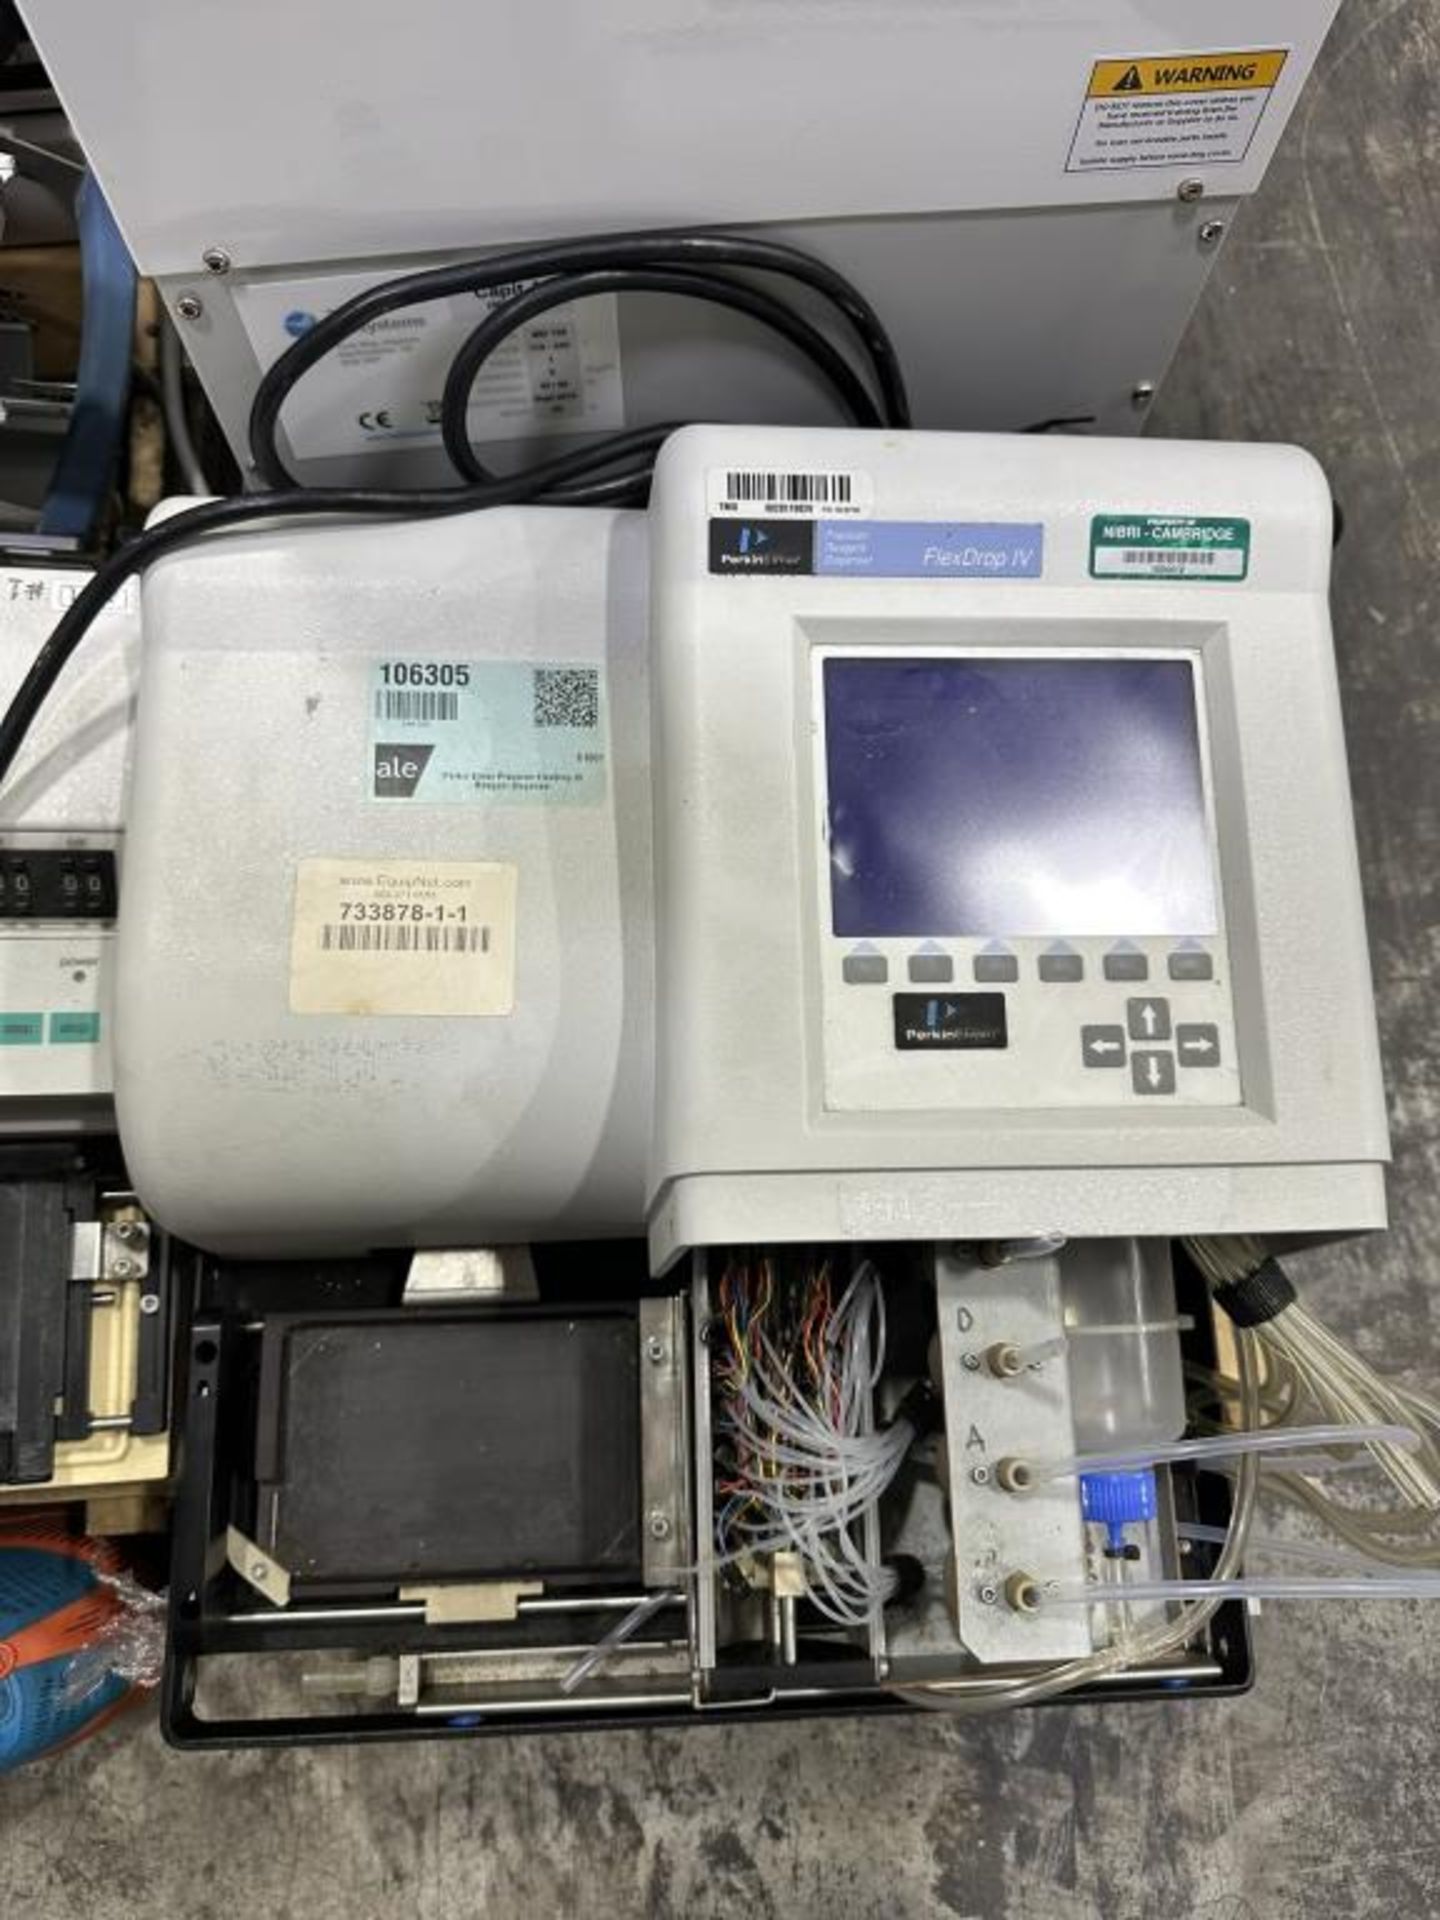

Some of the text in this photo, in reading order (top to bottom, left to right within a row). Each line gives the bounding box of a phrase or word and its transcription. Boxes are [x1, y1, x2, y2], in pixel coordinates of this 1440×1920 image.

[1153, 63, 1257, 85] WARNING
[1103, 526, 1140, 538] NIBRI
[1151, 527, 1235, 540] CAMBRIDGE
[922, 546, 1034, 569] FlexDrop IV
[380, 662, 470, 686] 106305
[376, 757, 418, 778] ale
[339, 902, 466, 922] 733878-1-1
[966, 1425, 985, 1452] A
